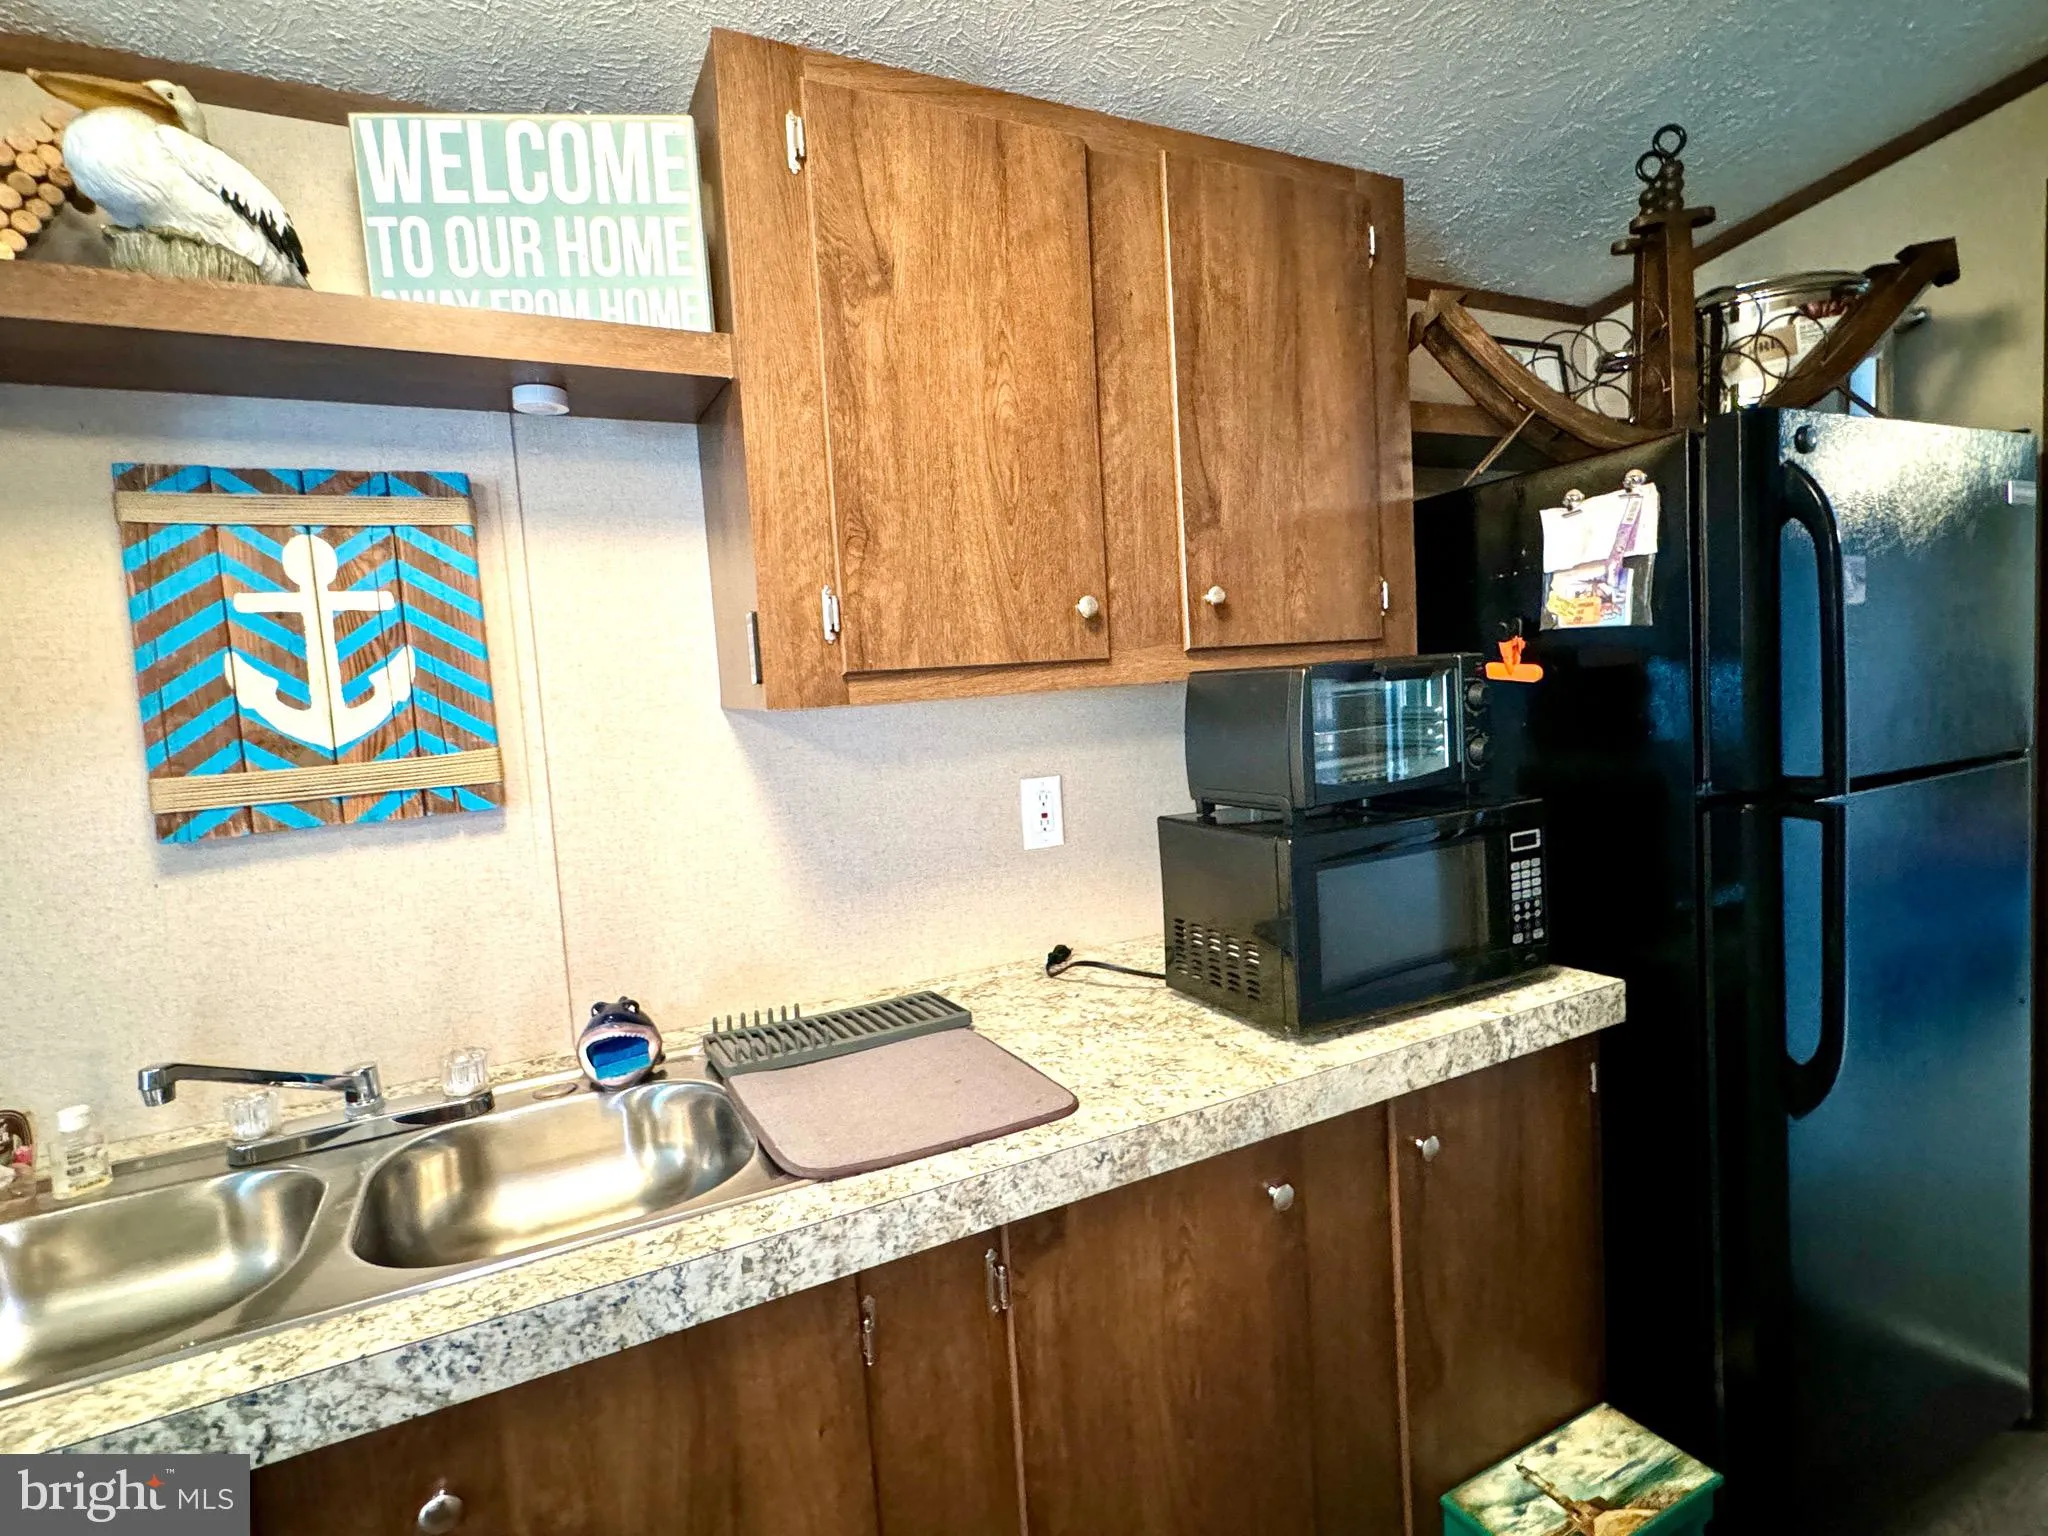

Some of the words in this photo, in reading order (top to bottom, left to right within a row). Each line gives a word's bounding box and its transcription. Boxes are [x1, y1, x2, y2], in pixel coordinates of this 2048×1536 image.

[358, 119, 690, 205] WELCOME
[366, 216, 434, 279] TO
[444, 215, 546, 279] OUR
[554, 215, 696, 279] HOME
[600, 287, 705, 332] HOME
